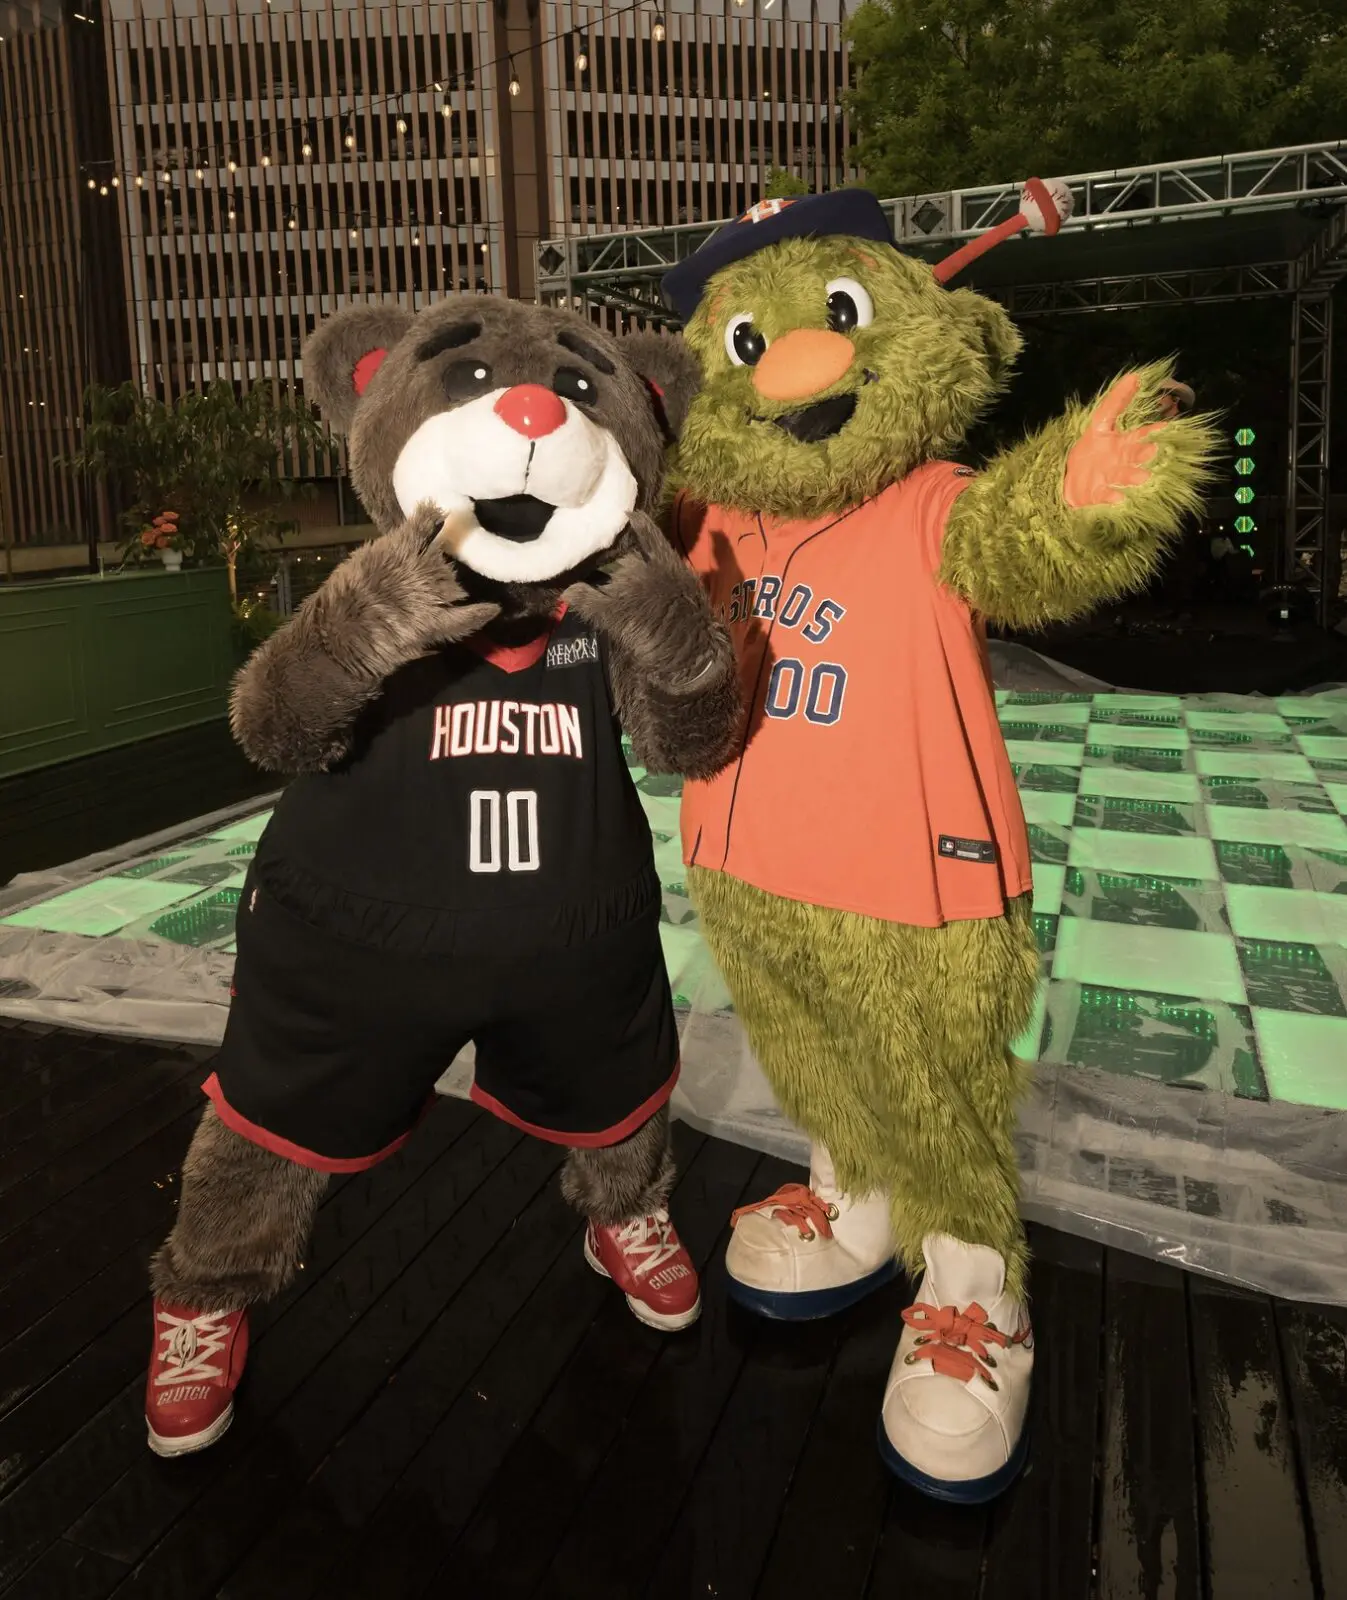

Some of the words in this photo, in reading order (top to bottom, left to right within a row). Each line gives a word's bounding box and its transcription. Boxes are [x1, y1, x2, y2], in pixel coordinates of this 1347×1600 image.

[720, 575, 847, 644] STROS
[764, 657, 848, 727] 00
[429, 700, 583, 761] HOUSTON
[469, 790, 540, 873] 00
[648, 1263, 691, 1290] CLUTCH
[156, 1386, 211, 1406] CLUTCH
